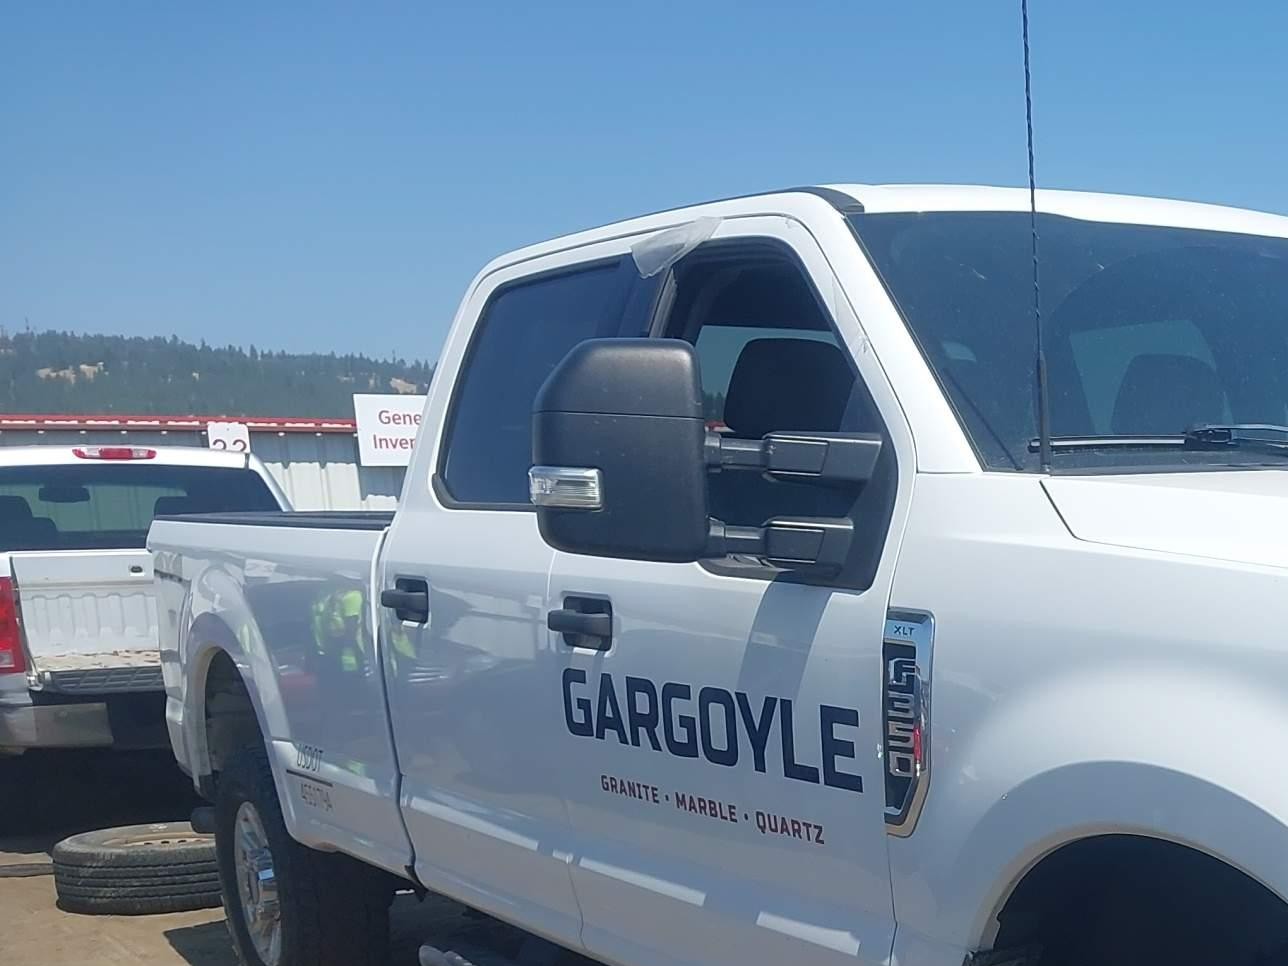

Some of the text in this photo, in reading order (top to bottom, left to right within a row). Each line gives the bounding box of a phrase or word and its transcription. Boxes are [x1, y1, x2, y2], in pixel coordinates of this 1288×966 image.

[893, 625, 915, 636] XLT
[562, 667, 864, 793] GARGOYLE
[600, 775, 825, 845] GRANITE MARBLE QUARTZ
